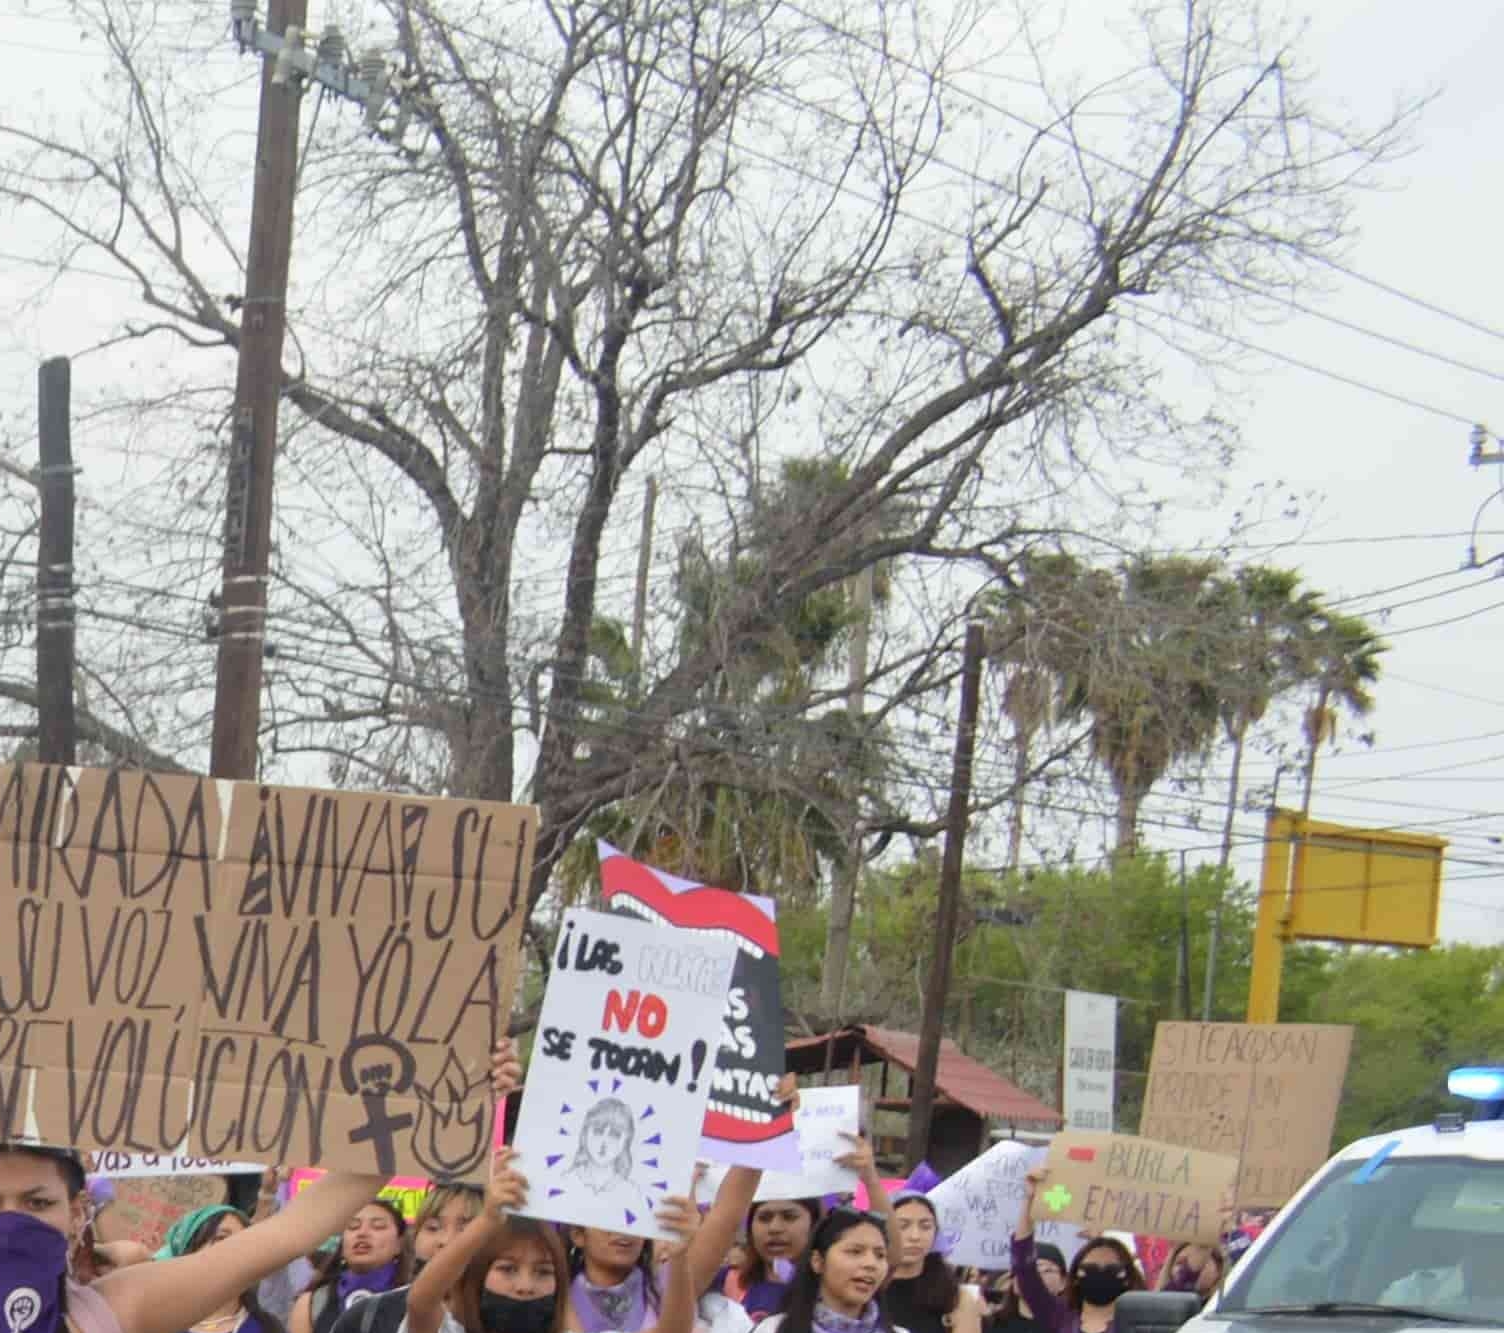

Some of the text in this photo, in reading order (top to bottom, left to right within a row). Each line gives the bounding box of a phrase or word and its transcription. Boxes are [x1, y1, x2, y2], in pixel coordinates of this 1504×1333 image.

[424, 806, 528, 942] SU
[193, 912, 321, 1045] VIVA
[602, 989, 668, 1039] NO
[542, 1027, 576, 1062] SE
[1105, 1142, 1190, 1186] BURLA
[1082, 1184, 1202, 1237] EMPATIA
